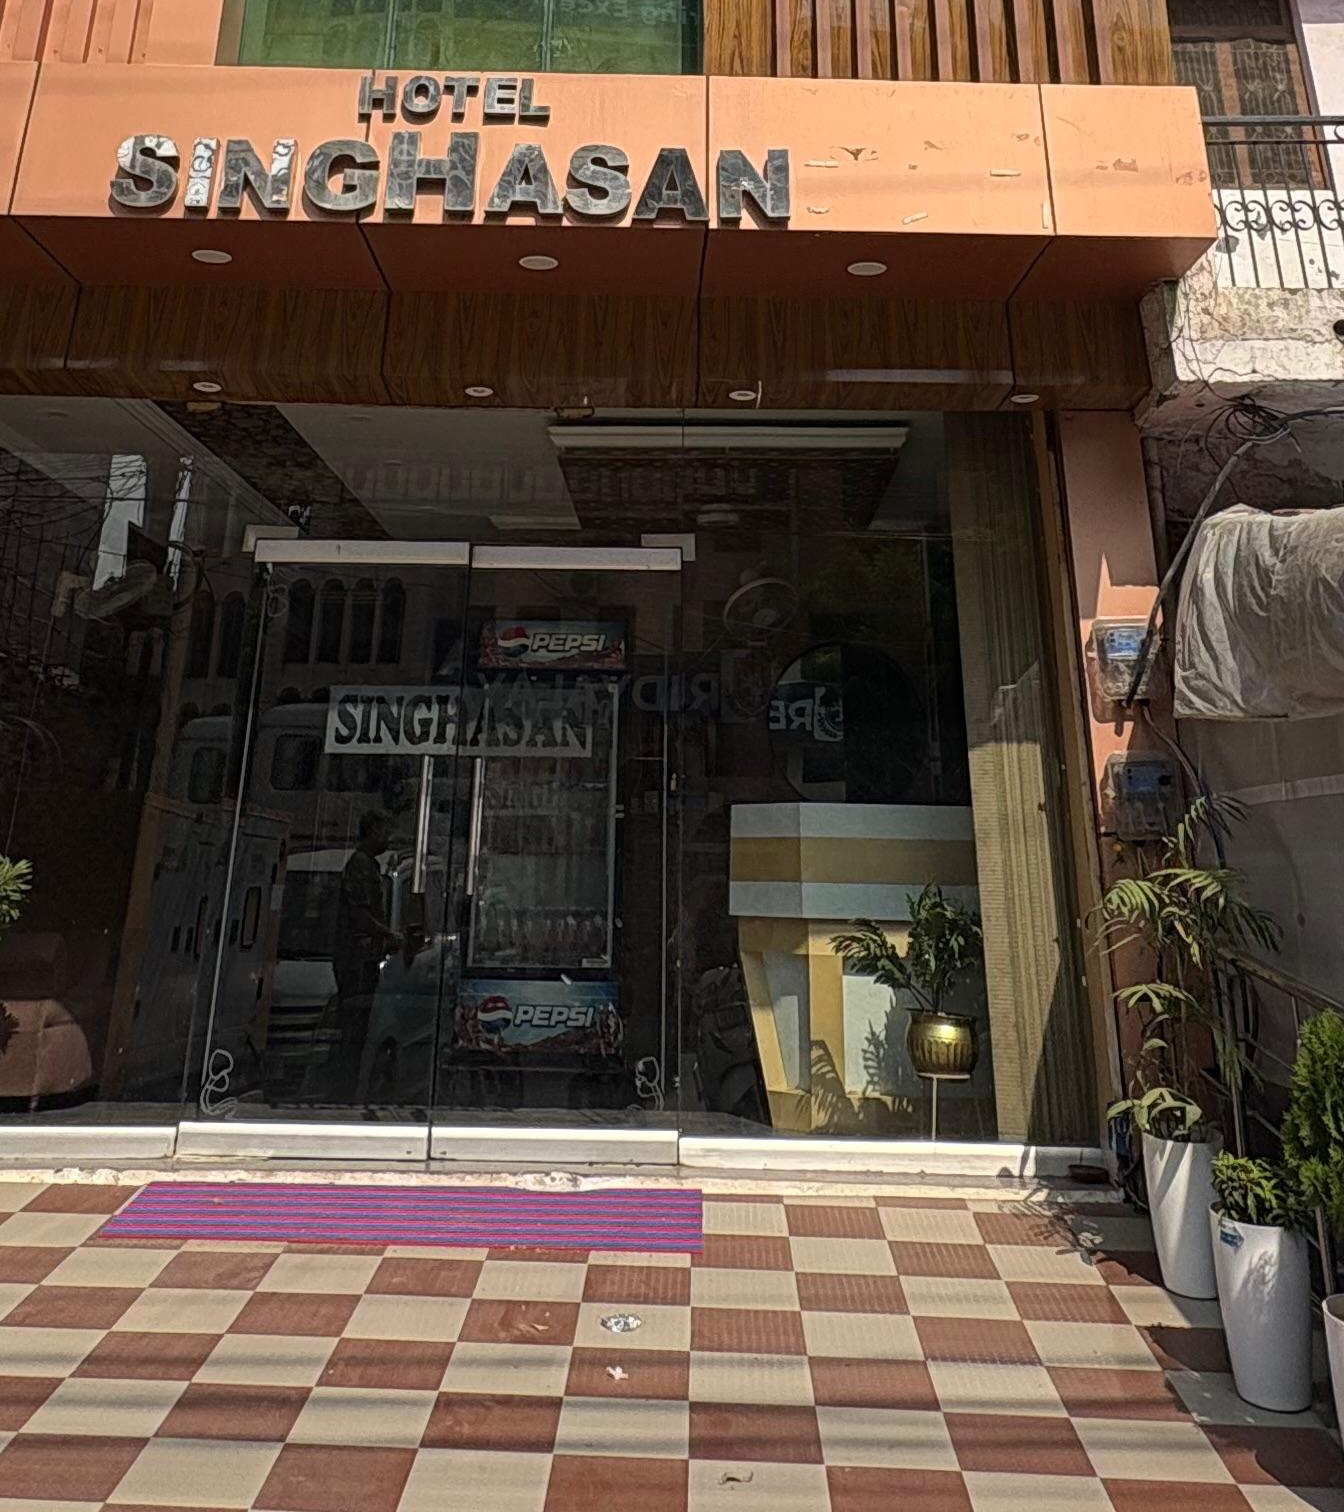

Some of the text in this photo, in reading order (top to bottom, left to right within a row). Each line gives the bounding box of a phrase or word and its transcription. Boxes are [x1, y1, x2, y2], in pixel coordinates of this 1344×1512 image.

[357, 74, 551, 124] HOTEL
[109, 131, 791, 222] SINGHASAN
[531, 631, 609, 654] PEPSI
[334, 693, 588, 750] SINGHASAN
[514, 1004, 595, 1028] PEPSI
